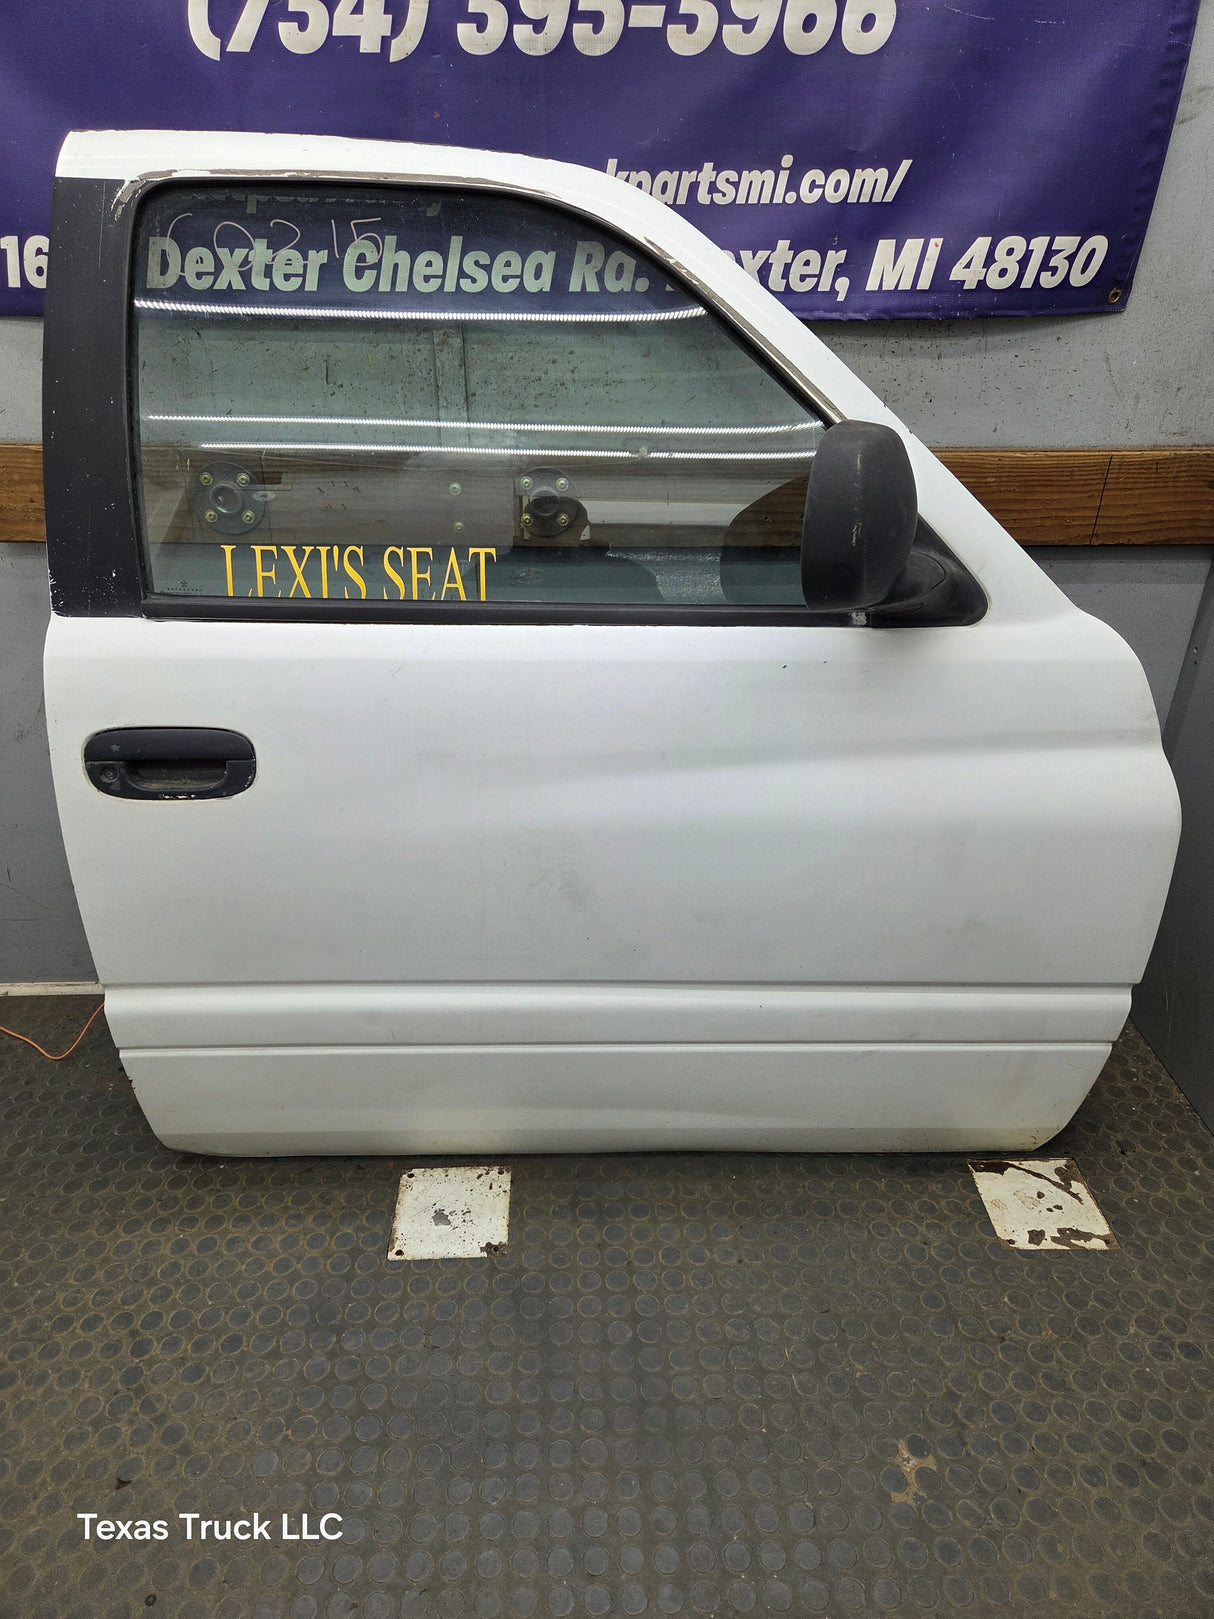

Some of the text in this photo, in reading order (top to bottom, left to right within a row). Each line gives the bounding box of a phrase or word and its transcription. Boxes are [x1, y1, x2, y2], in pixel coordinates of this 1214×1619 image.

[146, 236, 328, 292] Dexter
[343, 235, 556, 293] Chelsea
[721, 239, 850, 301] xter,
[865, 238, 944, 291] MI
[949, 235, 1109, 290] 48130
[220, 545, 497, 601] LEXI'S SEAT
